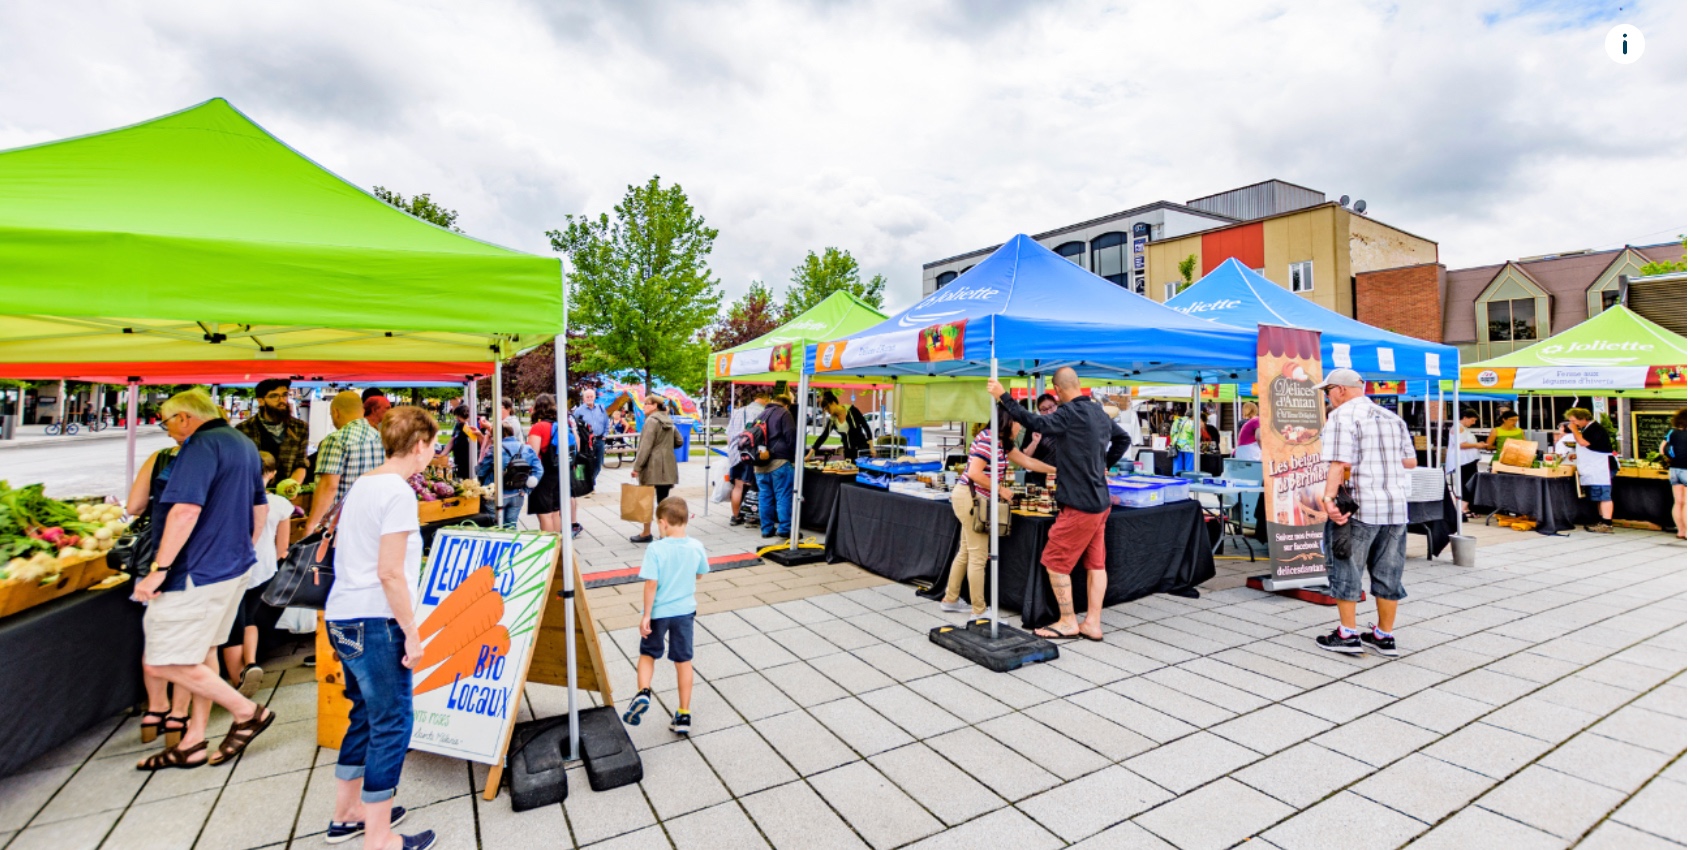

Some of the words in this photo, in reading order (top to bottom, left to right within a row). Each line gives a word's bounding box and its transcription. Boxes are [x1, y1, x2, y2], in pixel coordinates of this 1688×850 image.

[1567, 340, 1655, 352] Joliette
[1275, 395, 1316, 408] d'Antan
[1269, 460, 1290, 476] Les
[473, 644, 505, 681] Bio
[447, 672, 509, 720] Locaux
